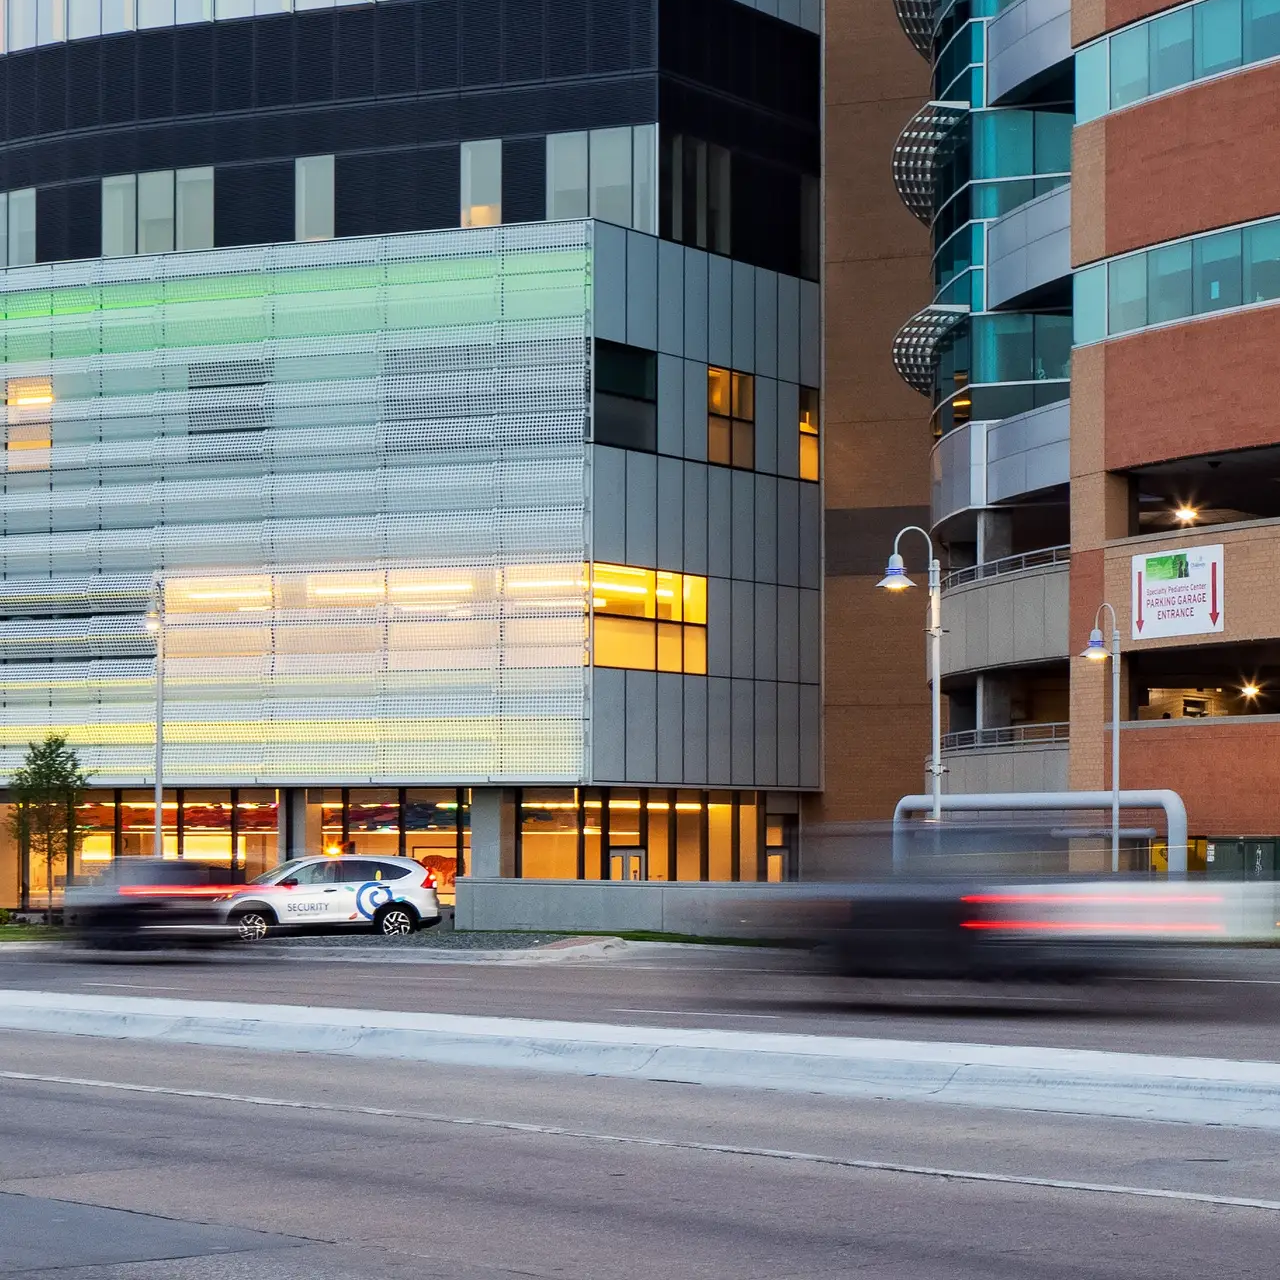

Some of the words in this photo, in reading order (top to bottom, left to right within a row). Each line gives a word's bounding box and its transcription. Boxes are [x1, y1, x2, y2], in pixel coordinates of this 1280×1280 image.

[1146, 587, 1167, 596] Specialty
[1168, 585, 1189, 594] Pediatric
[1190, 583, 1207, 591] Center
[1146, 596, 1176, 608] PARKING
[1178, 593, 1207, 605] GARAGE
[1157, 607, 1195, 620] ENTRANCE
[287, 903, 329, 912] SECURITY
